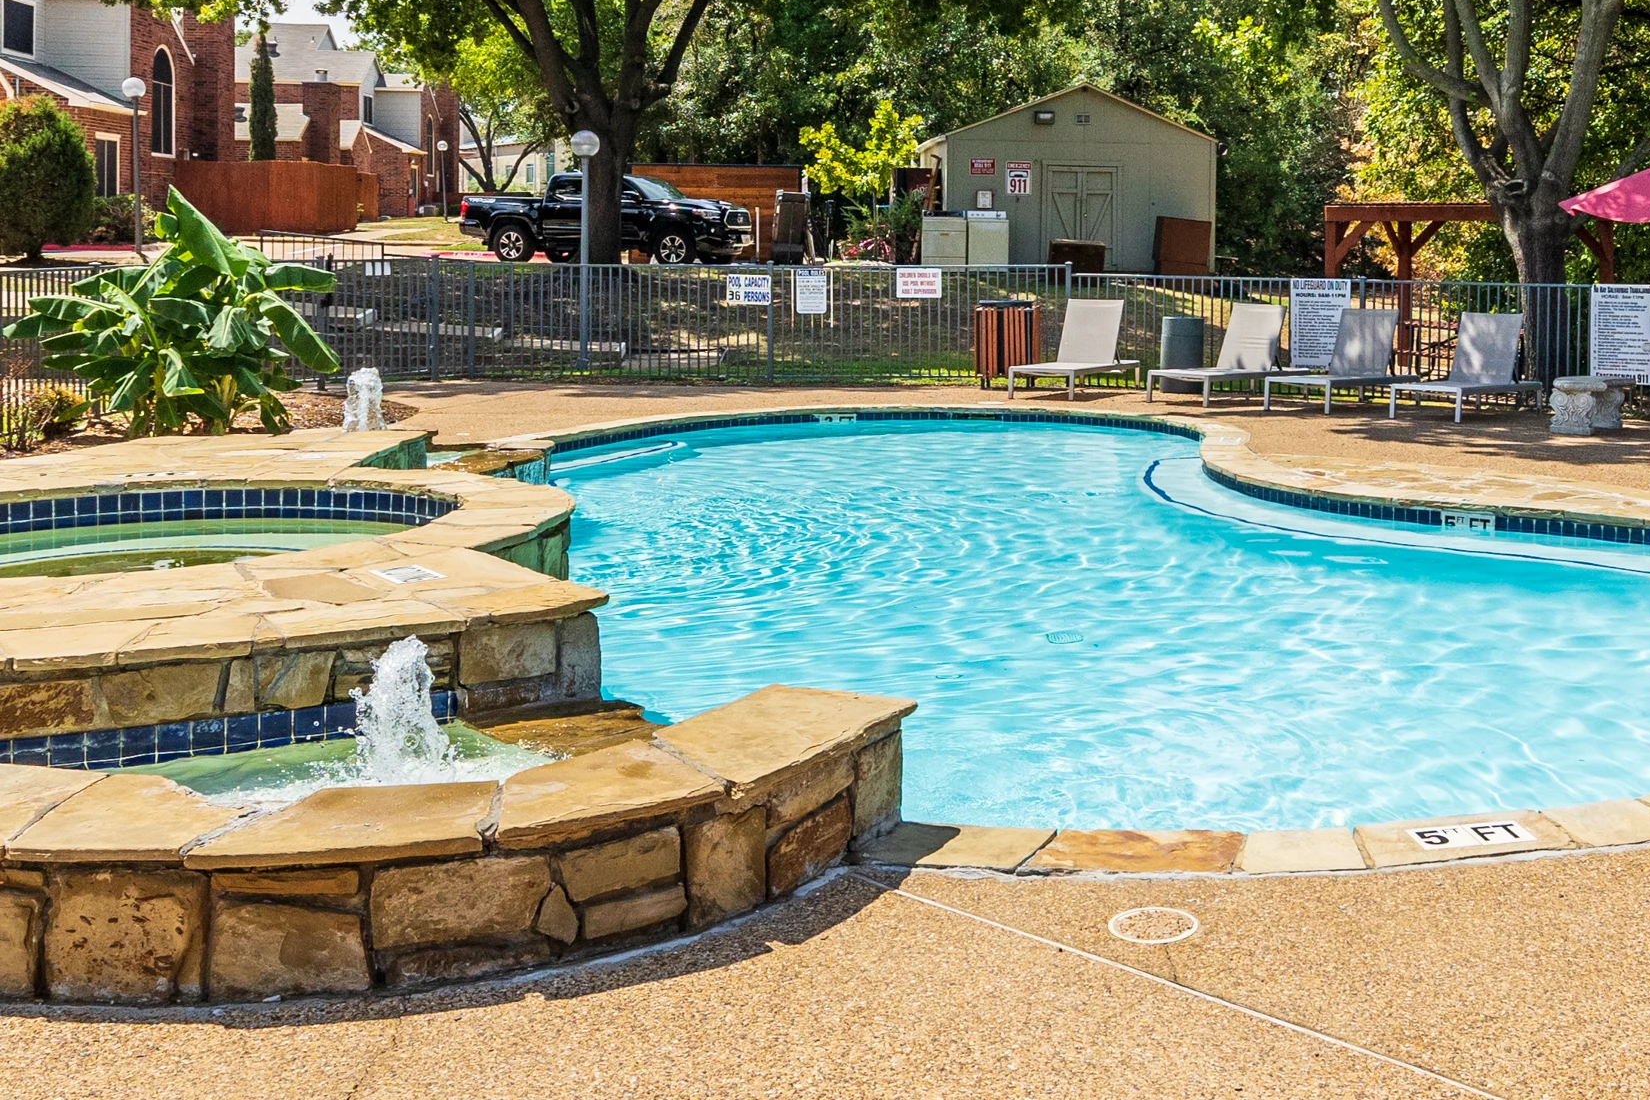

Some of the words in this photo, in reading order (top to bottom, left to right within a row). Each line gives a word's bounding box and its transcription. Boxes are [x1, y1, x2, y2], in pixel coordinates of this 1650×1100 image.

[1010, 179, 1027, 193] 911
[728, 276, 741, 287] POOL
[744, 276, 769, 288] CAPACITY
[1293, 280, 1299, 289] NO
[1300, 280, 1326, 290] LIFEGUARD
[1327, 281, 1334, 290] ON
[1335, 281, 1348, 290] DUTY
[729, 291, 740, 300] 36
[744, 291, 769, 302] PERSONS
[1637, 374, 1649, 383] 911
[1445, 515, 1456, 526] 5
[1415, 830, 1449, 845] 5
[1470, 823, 1520, 842] FT
